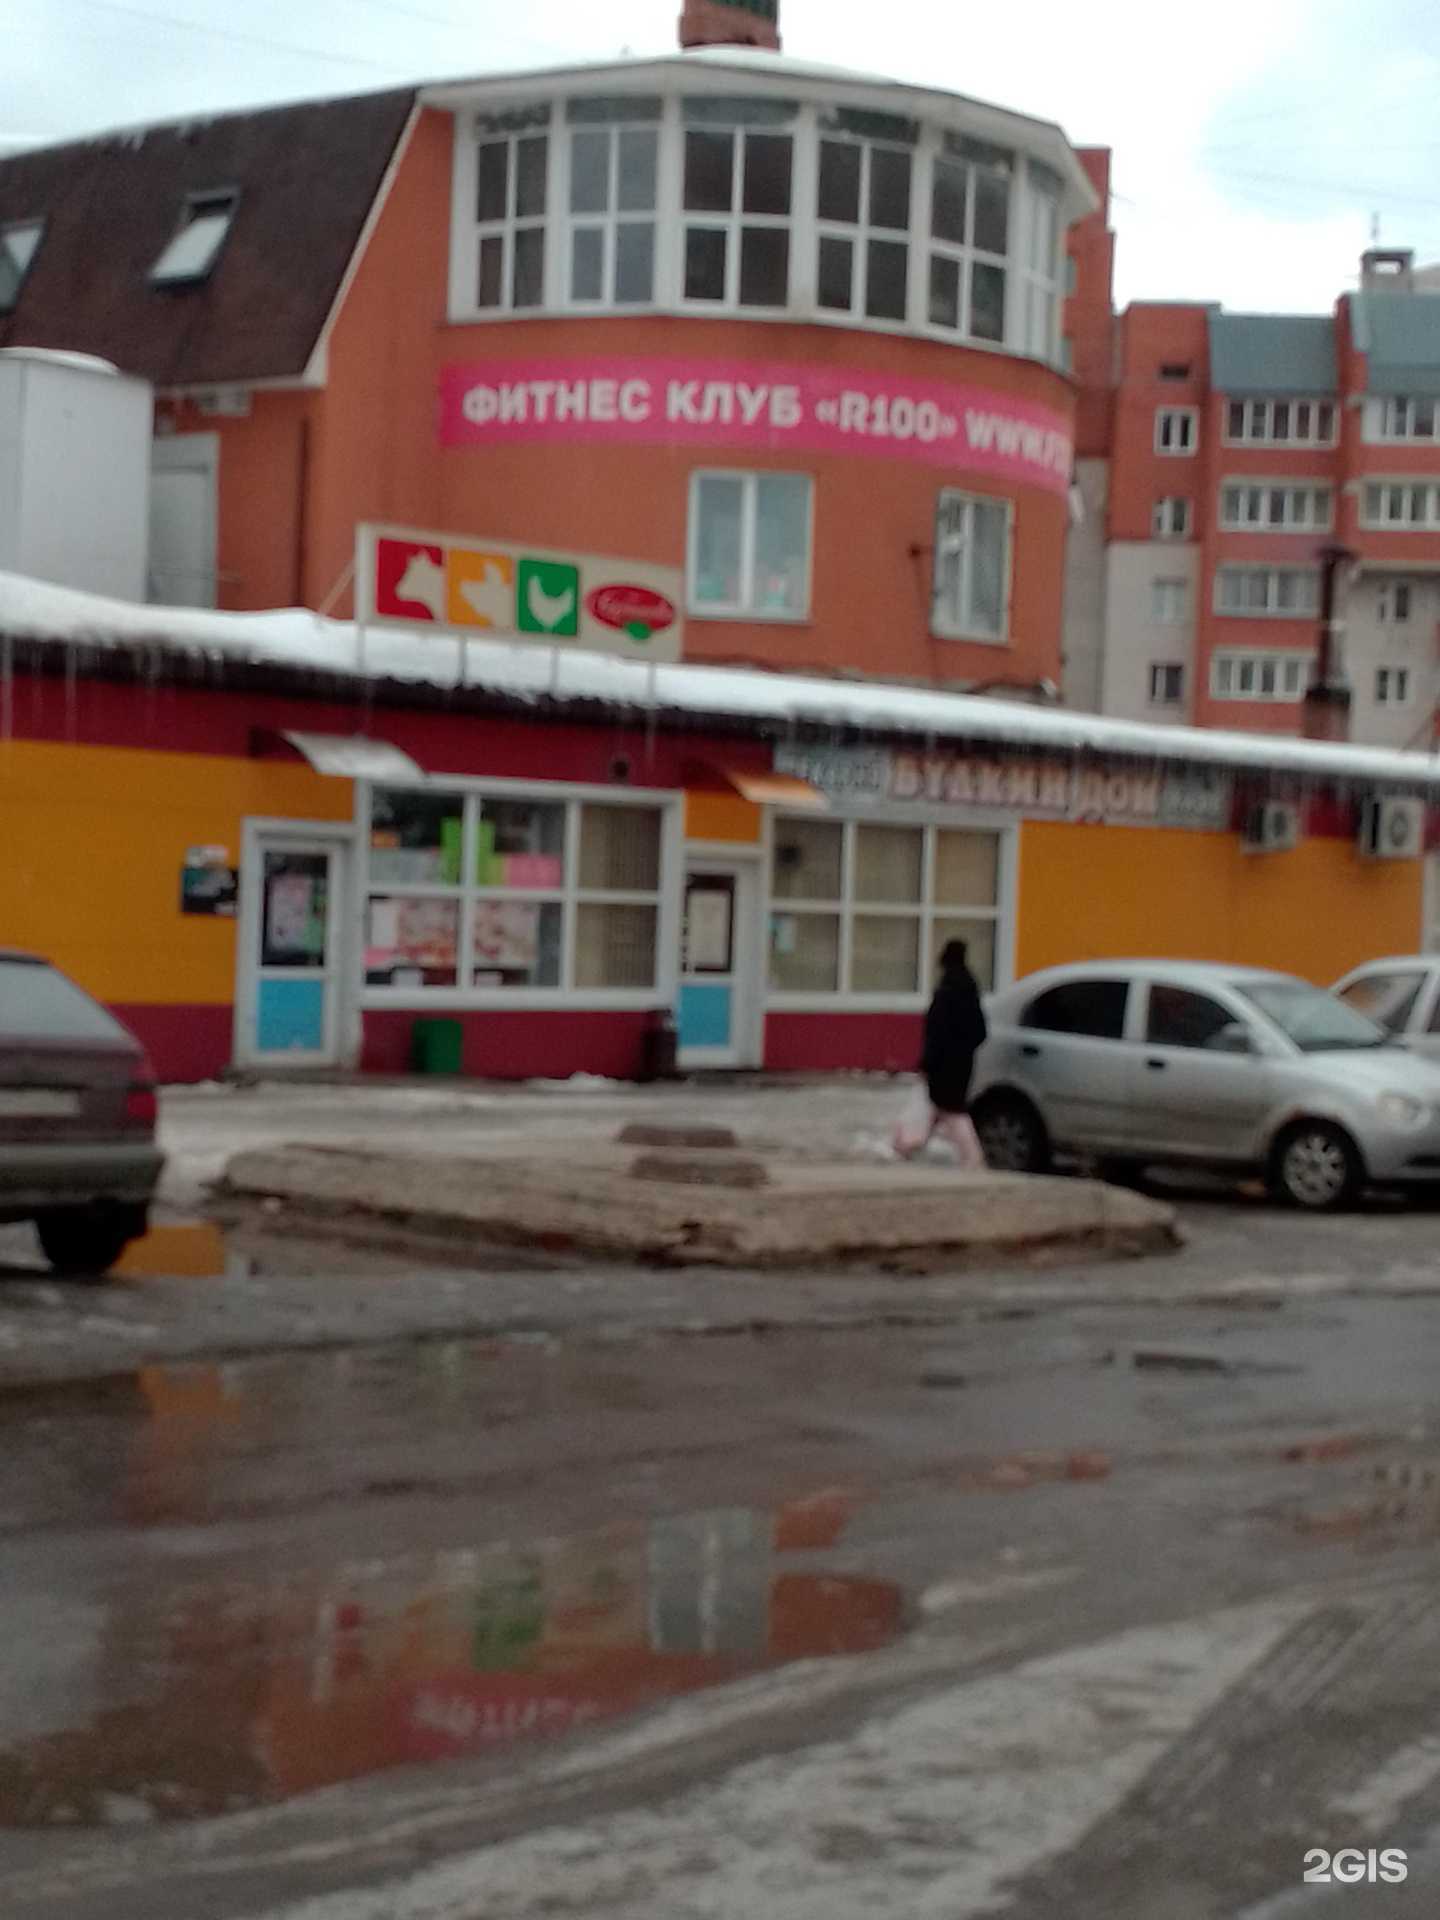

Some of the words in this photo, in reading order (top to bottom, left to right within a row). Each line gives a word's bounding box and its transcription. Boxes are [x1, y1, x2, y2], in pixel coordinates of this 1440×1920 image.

[463, 380, 650, 426] ФИТНЕС
[667, 381, 802, 427] КЛУБ
[816, 389, 957, 442] «R100»
